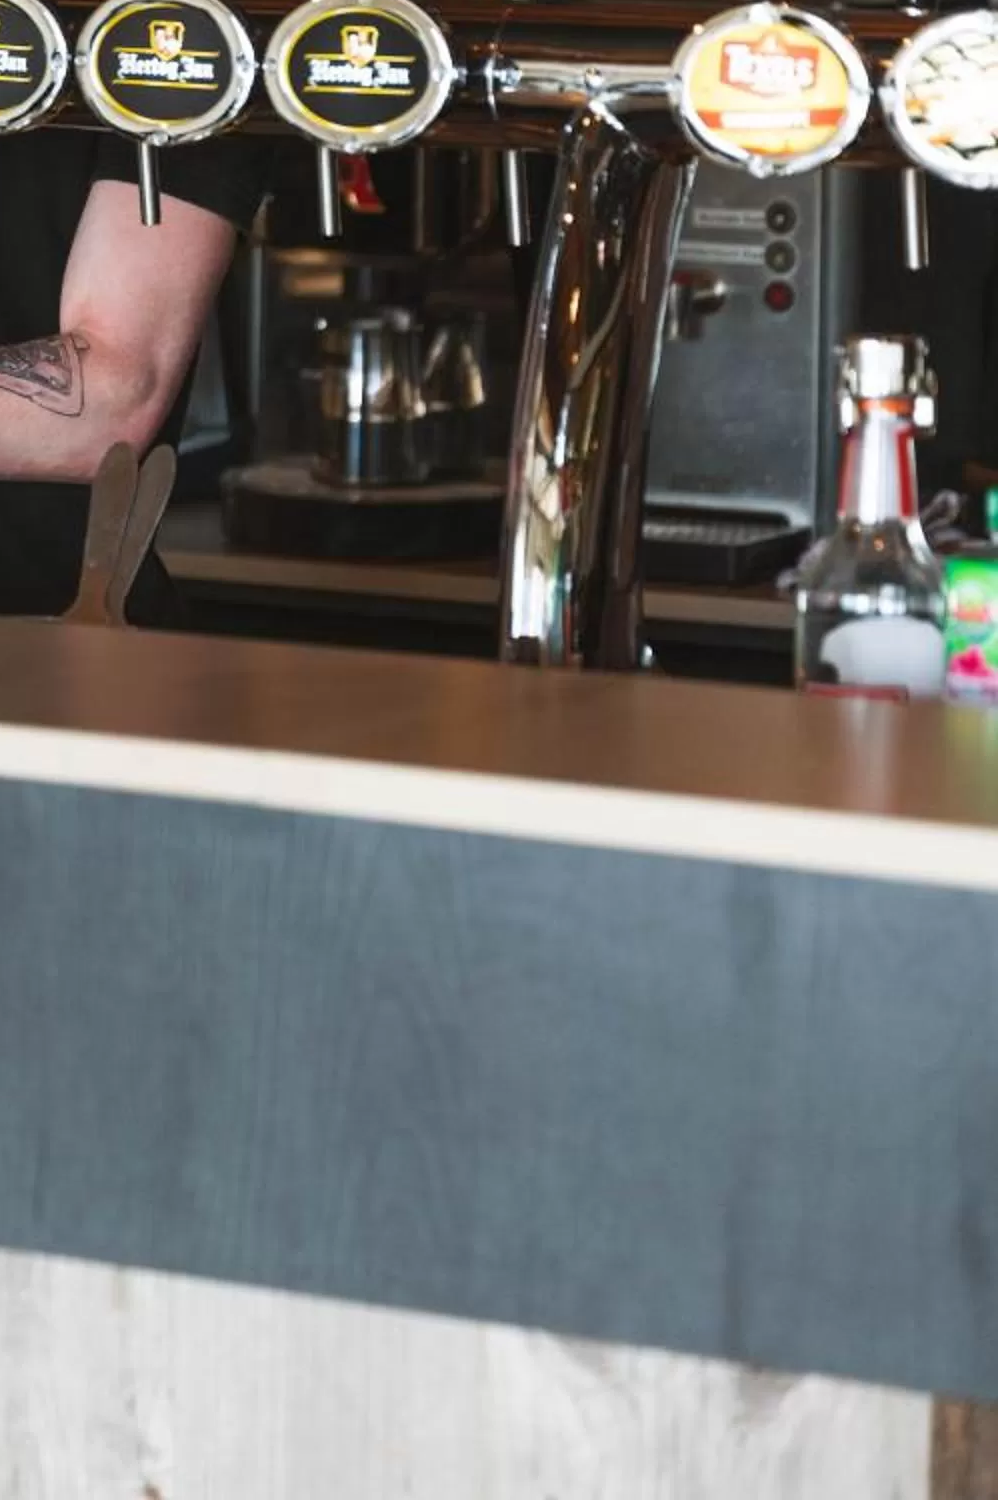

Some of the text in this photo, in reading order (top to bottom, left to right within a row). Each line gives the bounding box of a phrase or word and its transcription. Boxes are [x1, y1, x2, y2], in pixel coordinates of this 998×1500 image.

[117, 52, 215, 83] Hertog Jan
[308, 58, 411, 88] Hertog Jan
